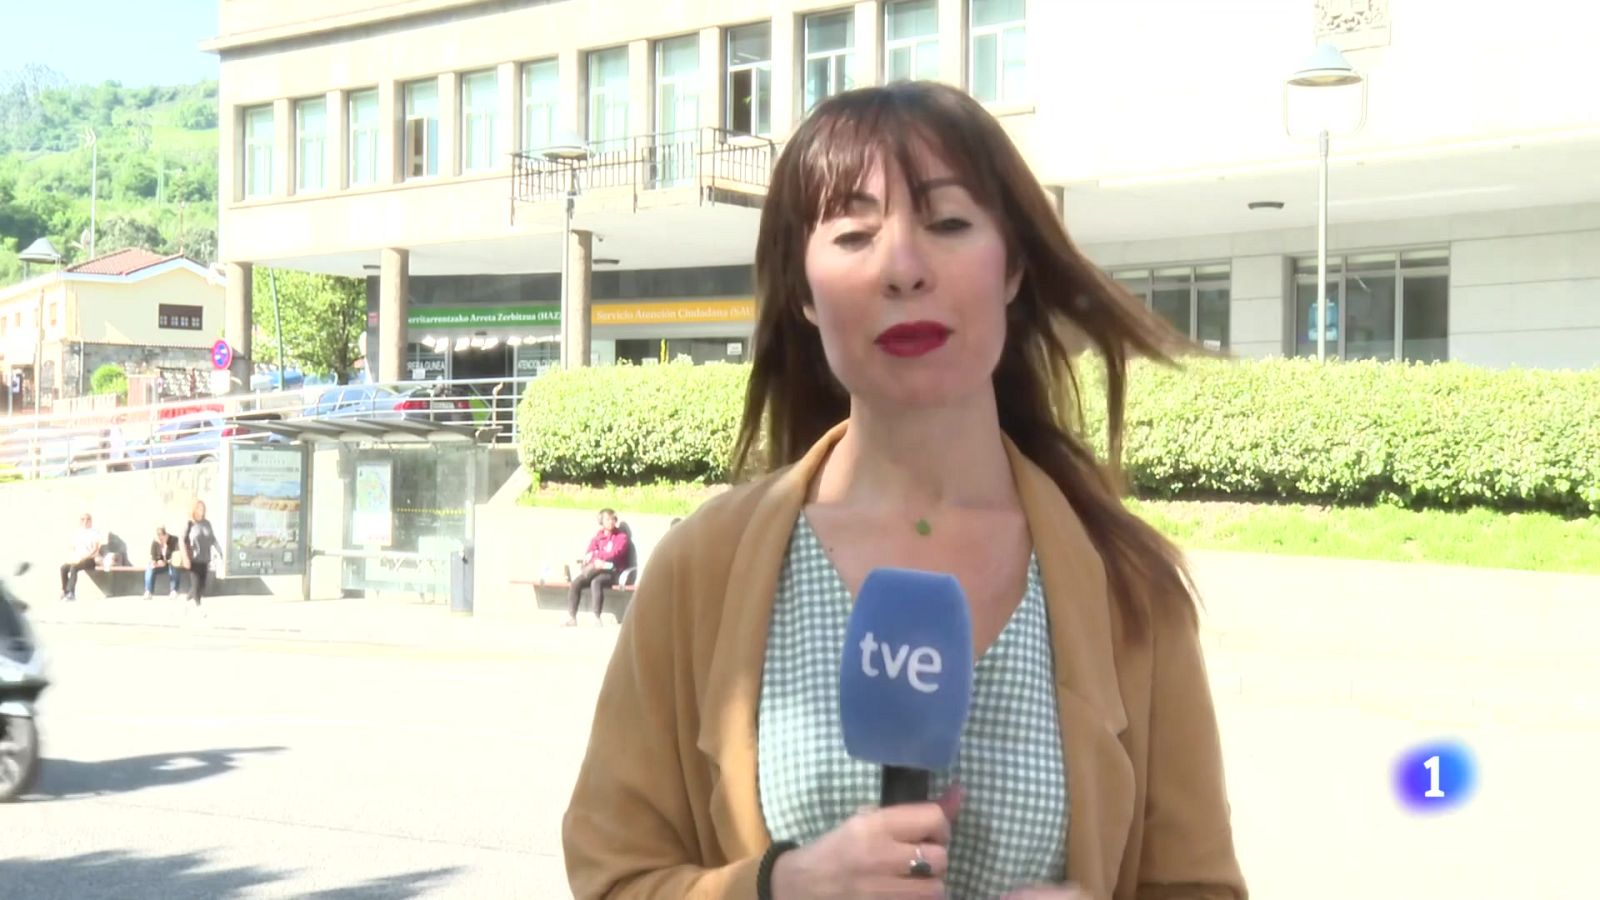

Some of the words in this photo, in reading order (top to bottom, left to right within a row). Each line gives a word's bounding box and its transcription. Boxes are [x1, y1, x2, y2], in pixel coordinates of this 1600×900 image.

[470, 313, 496, 323] Arreta
[498, 311, 536, 322] Zerbitzua
[596, 310, 634, 321] Servicio
[677, 307, 729, 319] Ciudadana
[859, 632, 942, 693] tve
